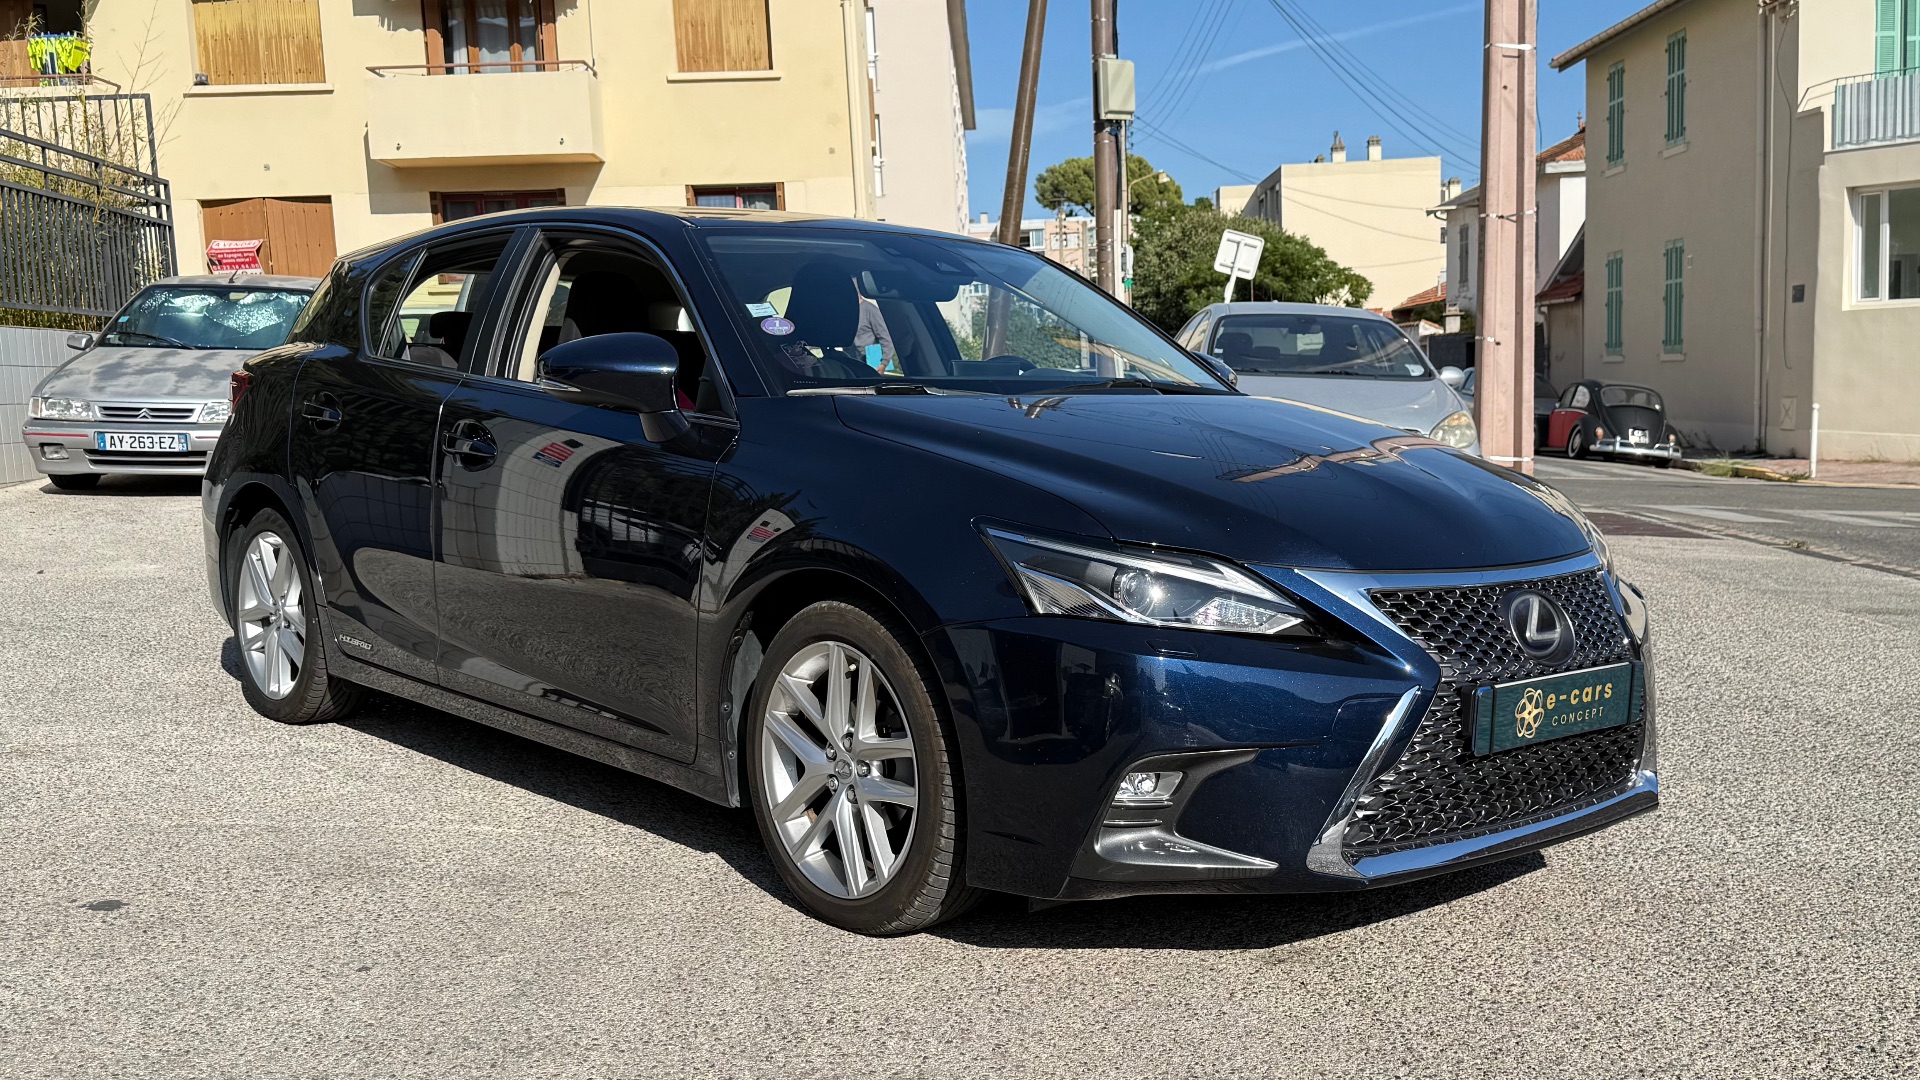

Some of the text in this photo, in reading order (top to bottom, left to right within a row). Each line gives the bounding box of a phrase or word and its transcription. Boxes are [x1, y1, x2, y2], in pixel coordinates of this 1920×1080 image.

[109, 435, 176, 450] AY-263-EZ
[1546, 683, 1613, 710] e-cars
[1551, 706, 1604, 726] CONCEPT
